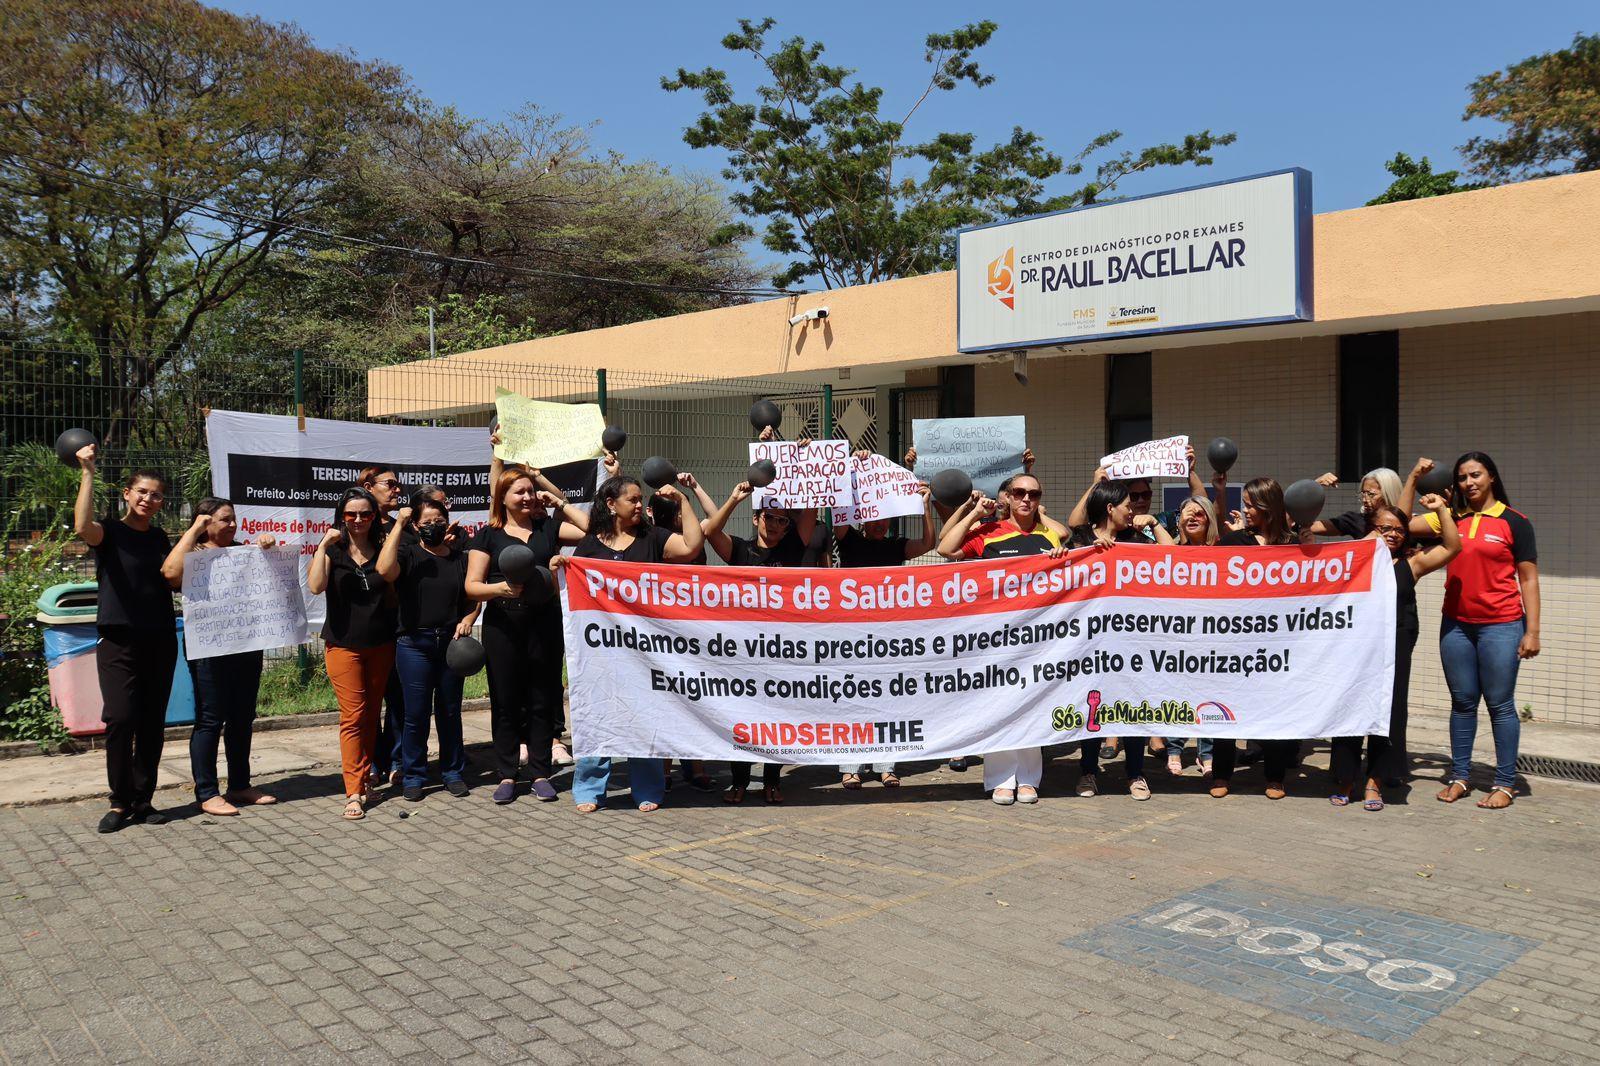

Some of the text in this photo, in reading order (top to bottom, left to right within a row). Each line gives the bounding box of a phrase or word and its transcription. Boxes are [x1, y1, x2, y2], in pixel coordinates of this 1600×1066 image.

[1020, 221, 1245, 264] CENTRO DE DIAGNÓSTICO POR EXAMES
[1020, 238, 1246, 293] DR. RAUL BACELLAR
[1073, 308, 1096, 319] FMS
[1119, 305, 1156, 317] Teresina
[952, 425, 1003, 440] QUEREMOS
[755, 443, 846, 464] QUEREMOS
[930, 440, 973, 454] SALÁRIO
[1112, 448, 1184, 464] SALARIAL
[311, 466, 490, 486] TERESIN MERECE ESTA VE
[774, 458, 846, 480] UIPARAÇÃO
[1112, 465, 1131, 477] LC
[1152, 461, 1186, 476] 4.730
[765, 477, 843, 496] SALARIAL
[851, 470, 918, 491] UMPRIMENT
[246, 486, 286, 500] Prefeito
[287, 488, 311, 500] José
[448, 494, 485, 506] cimentos
[761, 495, 778, 509] LC
[800, 495, 836, 509] 4.730
[852, 491, 870, 506] LC
[892, 482, 919, 497] 4.730
[241, 517, 333, 534] Agentes de Porta
[834, 505, 880, 526] DE 2015
[584, 551, 1354, 611] Profissionais de Saúde de Teresina pedem Socorro!
[584, 605, 1354, 664] Cuidamos de vidas preciosas e precisamos preservar nossas vidas!
[651, 649, 1290, 703] Exigimos condições de trabalho, respeito e Valorização!
[732, 720, 924, 746] SINDSERMTHE
[733, 744, 765, 754] SINDICATO
[780, 747, 818, 755] SERVIDORES
[818, 746, 849, 754] PÚBLICOS
[849, 746, 884, 754] MUNICIPAIS
[894, 744, 925, 752] TERESINA
[1142, 902, 1457, 993] IDOSO
